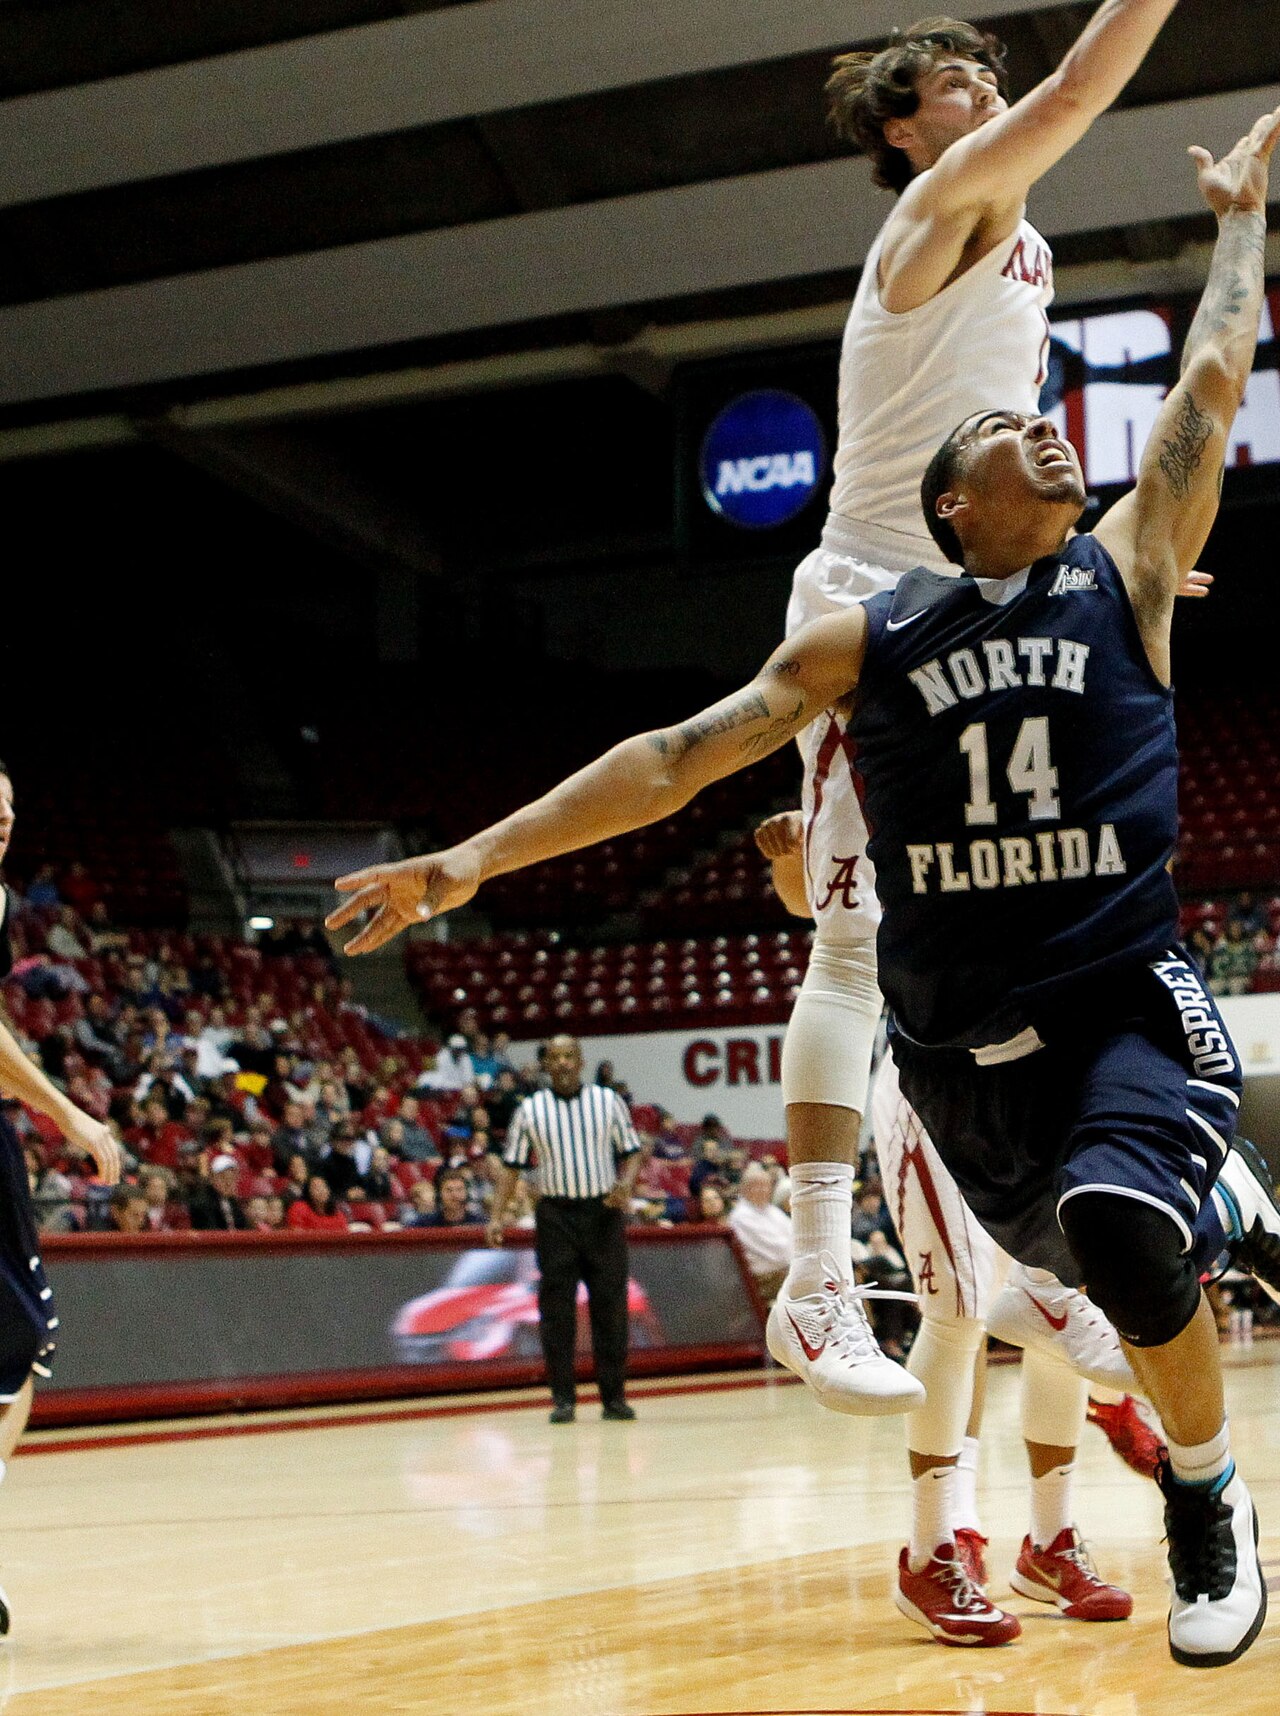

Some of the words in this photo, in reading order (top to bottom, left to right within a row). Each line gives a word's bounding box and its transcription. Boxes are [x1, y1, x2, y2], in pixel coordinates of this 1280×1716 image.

[716, 451, 815, 496] NCAA
[907, 636, 1091, 717] NORTH
[958, 715, 1062, 827] 14
[905, 823, 1127, 894] FLORIDA
